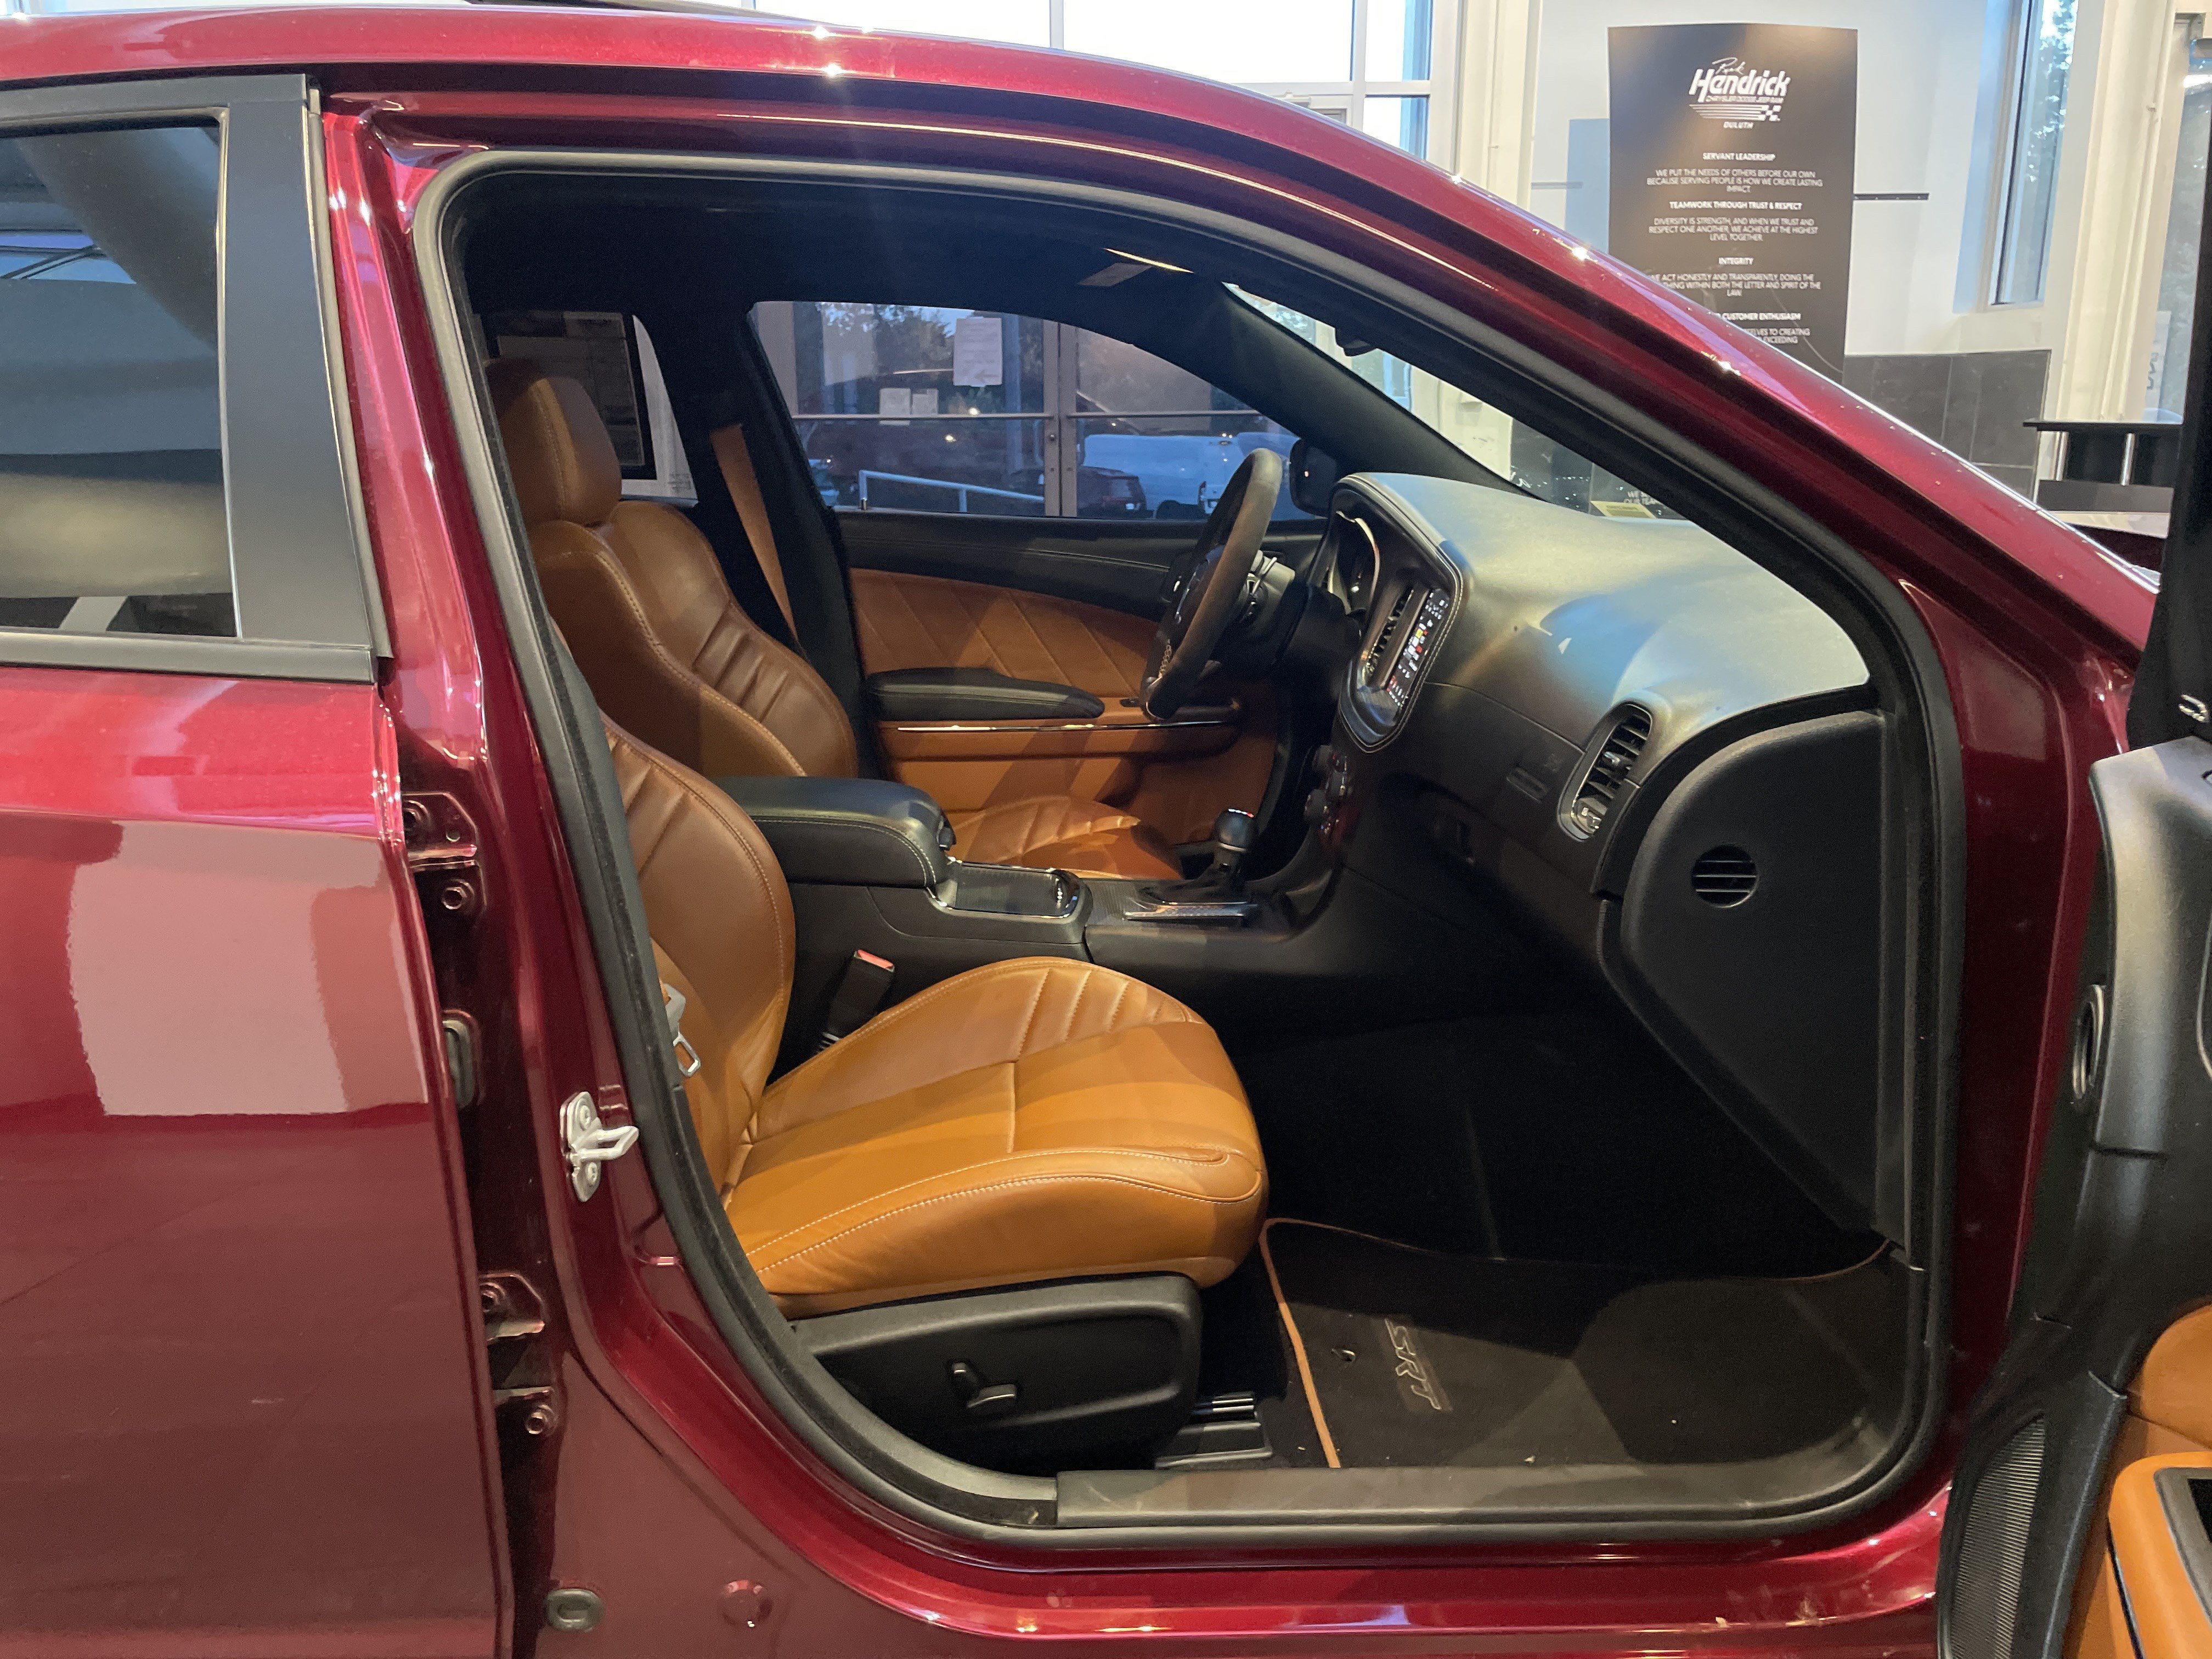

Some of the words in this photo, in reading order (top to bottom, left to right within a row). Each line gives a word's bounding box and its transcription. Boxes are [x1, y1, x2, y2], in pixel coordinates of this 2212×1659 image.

[1689, 69, 1791, 103] Hendrick
[1735, 153, 1776, 161] LEADERSHIP
[1726, 185, 1751, 193] IMPACT
[1775, 202, 1802, 210] RESPECT
[1654, 217, 1688, 225] DIVERSITY
[1679, 225, 1696, 233] ONE
[1661, 274, 1676, 282] ACT
[1779, 328, 1810, 336] CREATING
[1384, 1318, 1442, 1410] SRT
